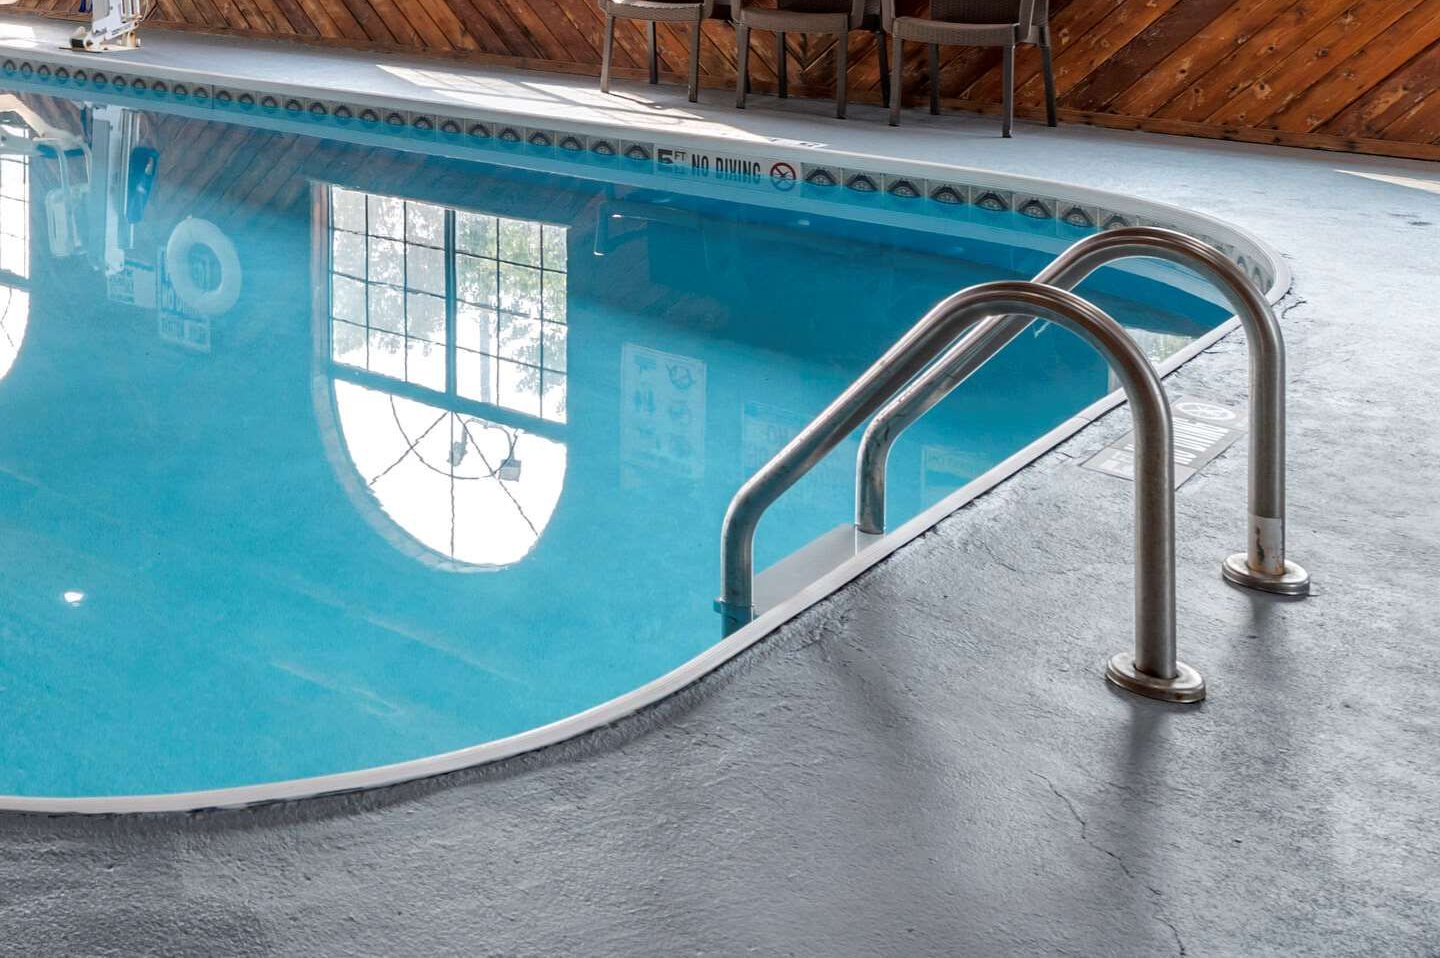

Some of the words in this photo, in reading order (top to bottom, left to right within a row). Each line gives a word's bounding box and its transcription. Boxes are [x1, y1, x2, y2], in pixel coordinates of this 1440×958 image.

[657, 148, 674, 164] 5
[674, 150, 687, 161] FT
[691, 154, 709, 172] NO
[715, 156, 761, 179] DIVING
